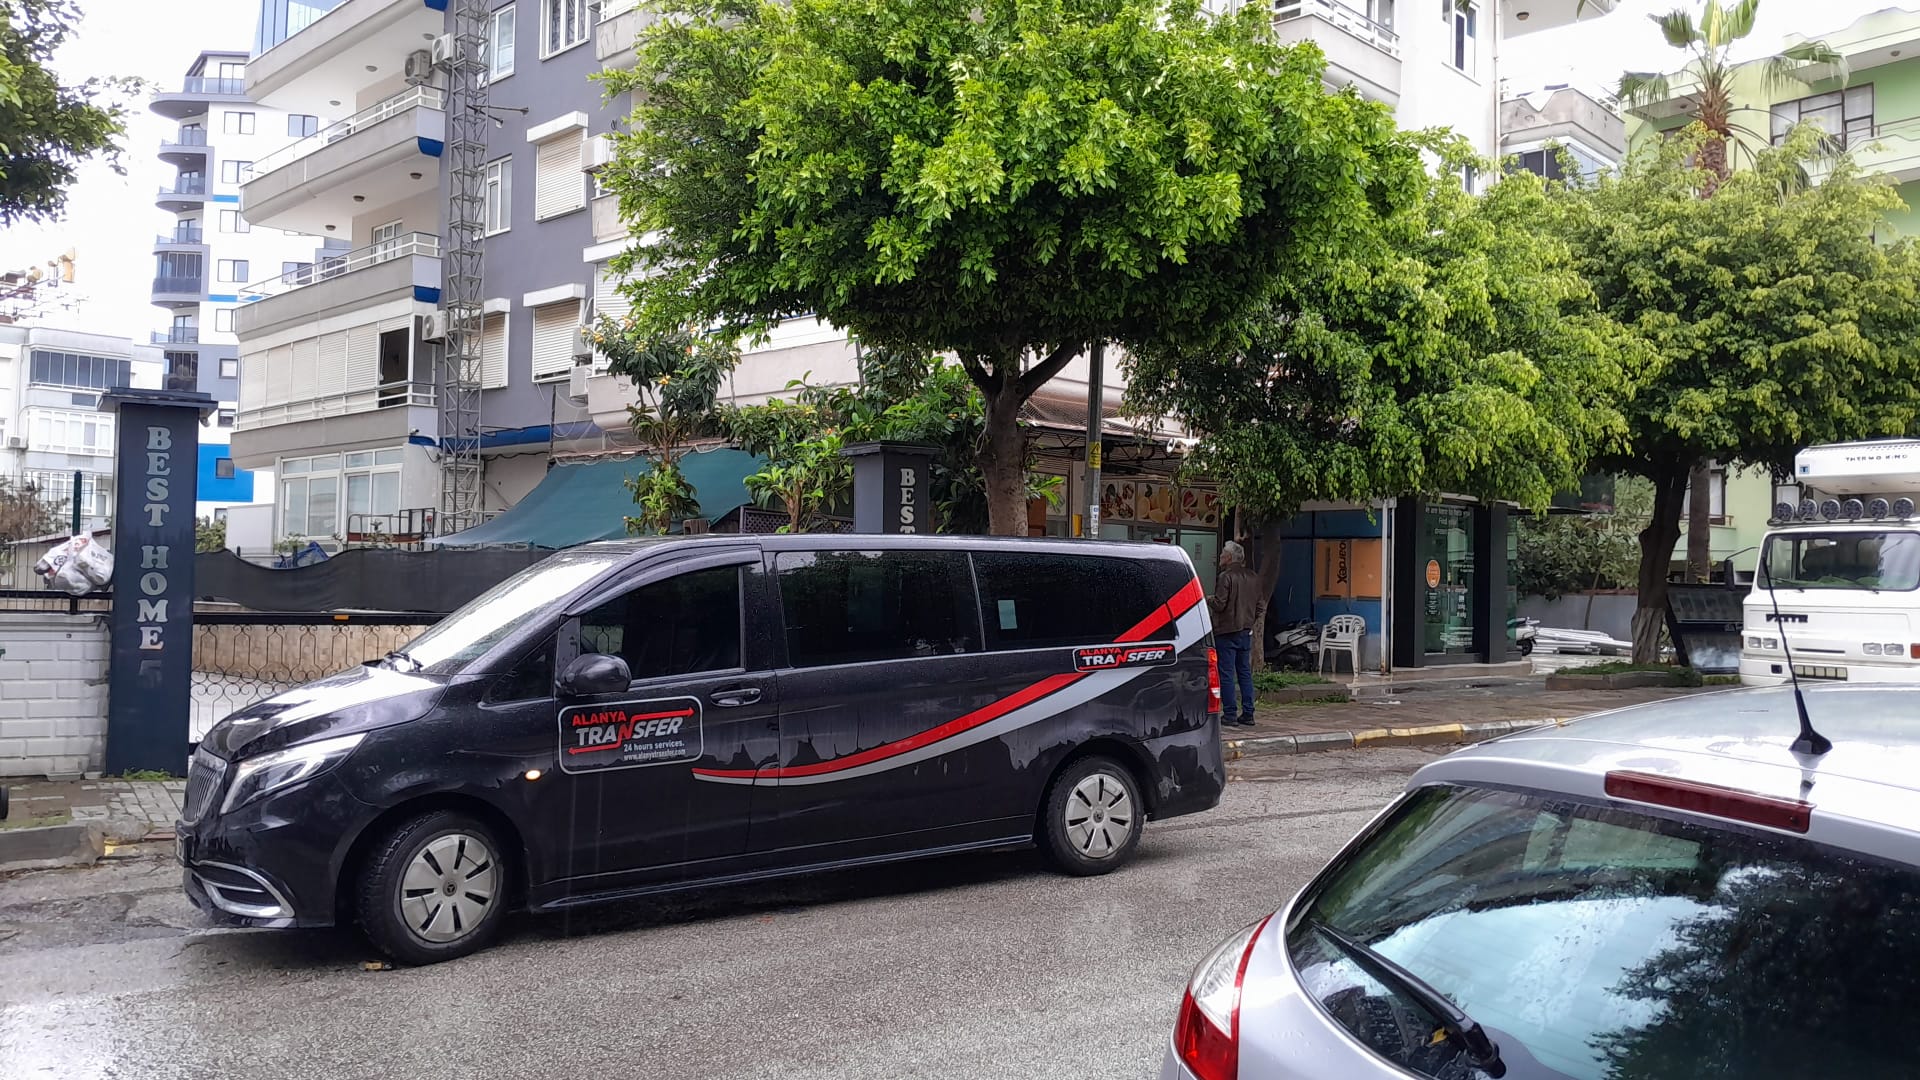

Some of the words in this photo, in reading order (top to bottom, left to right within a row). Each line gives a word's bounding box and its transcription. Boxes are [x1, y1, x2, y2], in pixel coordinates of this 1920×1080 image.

[143, 426, 172, 527] BEST
[136, 545, 170, 650] HOME
[1079, 648, 1121, 656] ALANYA
[1082, 650, 1166, 666] TRANSFER
[572, 711, 627, 726] ALANYA
[575, 716, 684, 746] TRANSFER
[623, 743, 633, 752] 24
[633, 743, 653, 751] hours
[654, 740, 685, 749] services.
